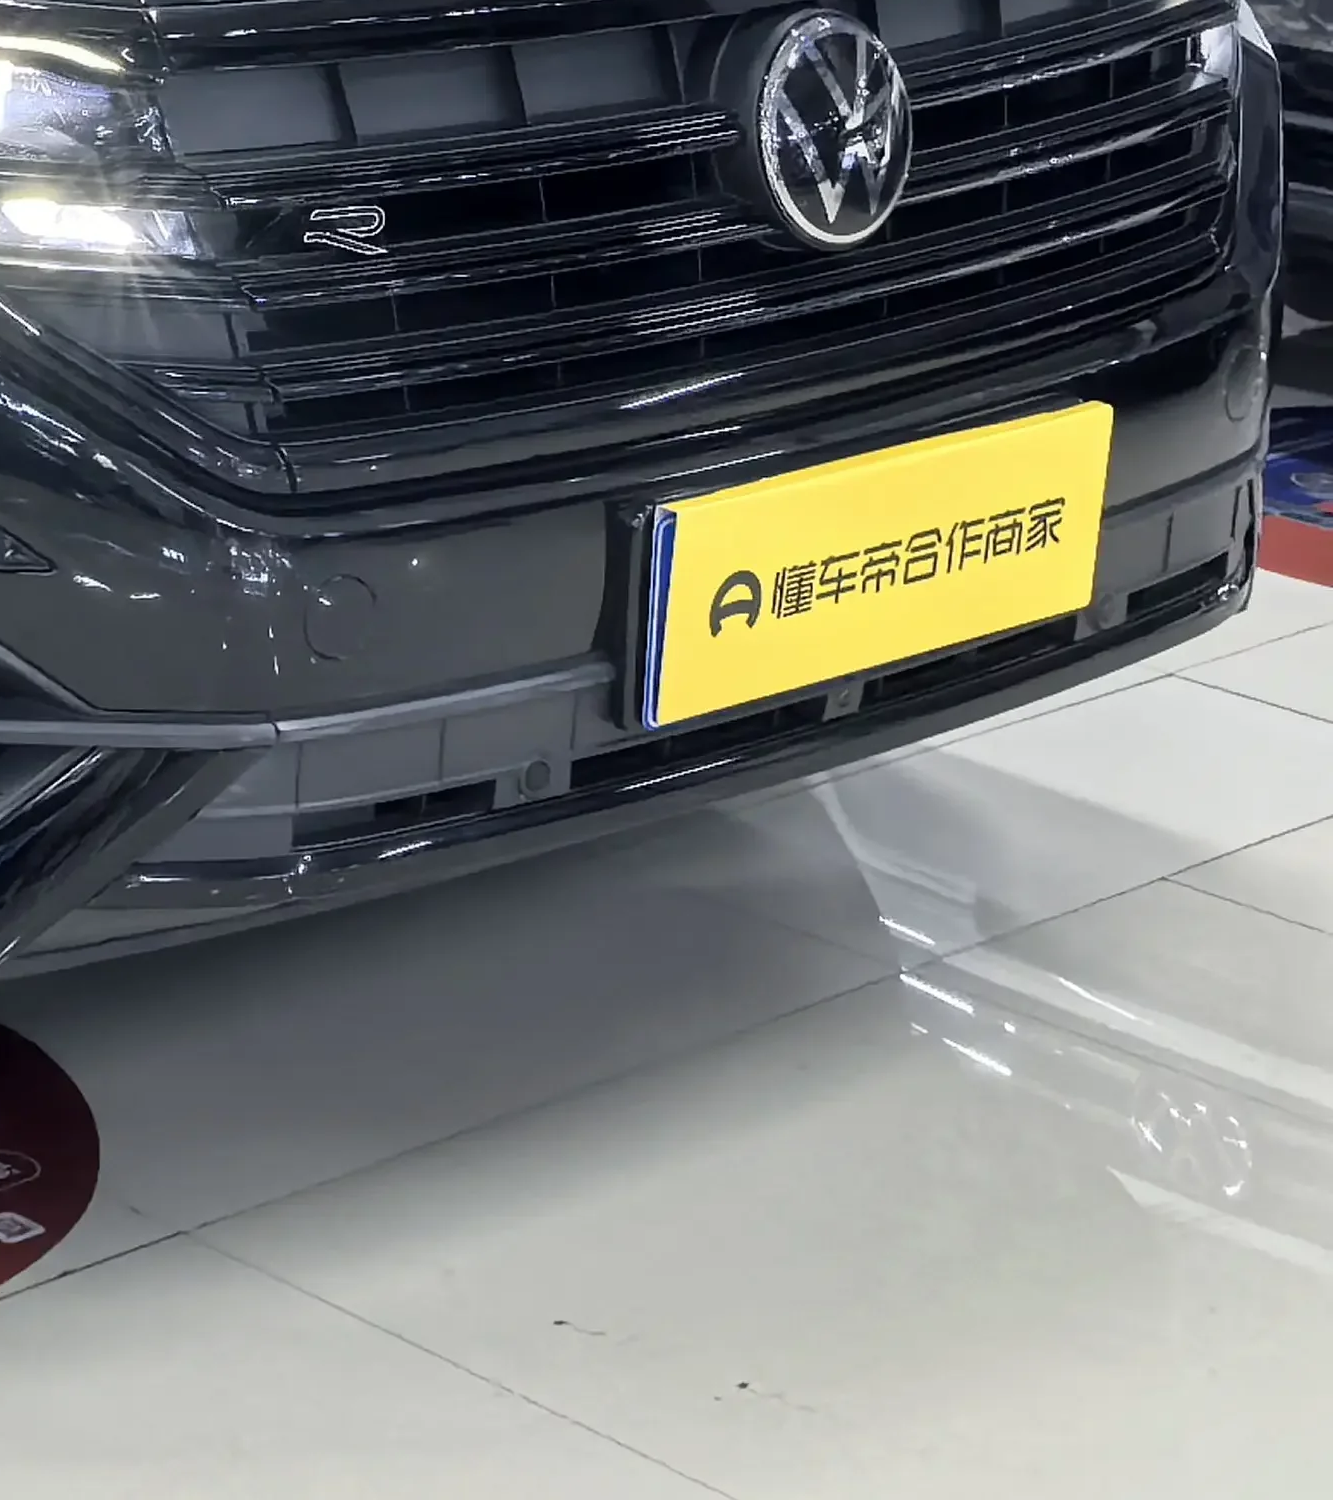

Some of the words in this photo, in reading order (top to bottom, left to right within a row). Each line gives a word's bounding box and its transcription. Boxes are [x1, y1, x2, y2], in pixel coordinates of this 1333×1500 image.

[770, 496, 1066, 620] 懂车帝合作商家
